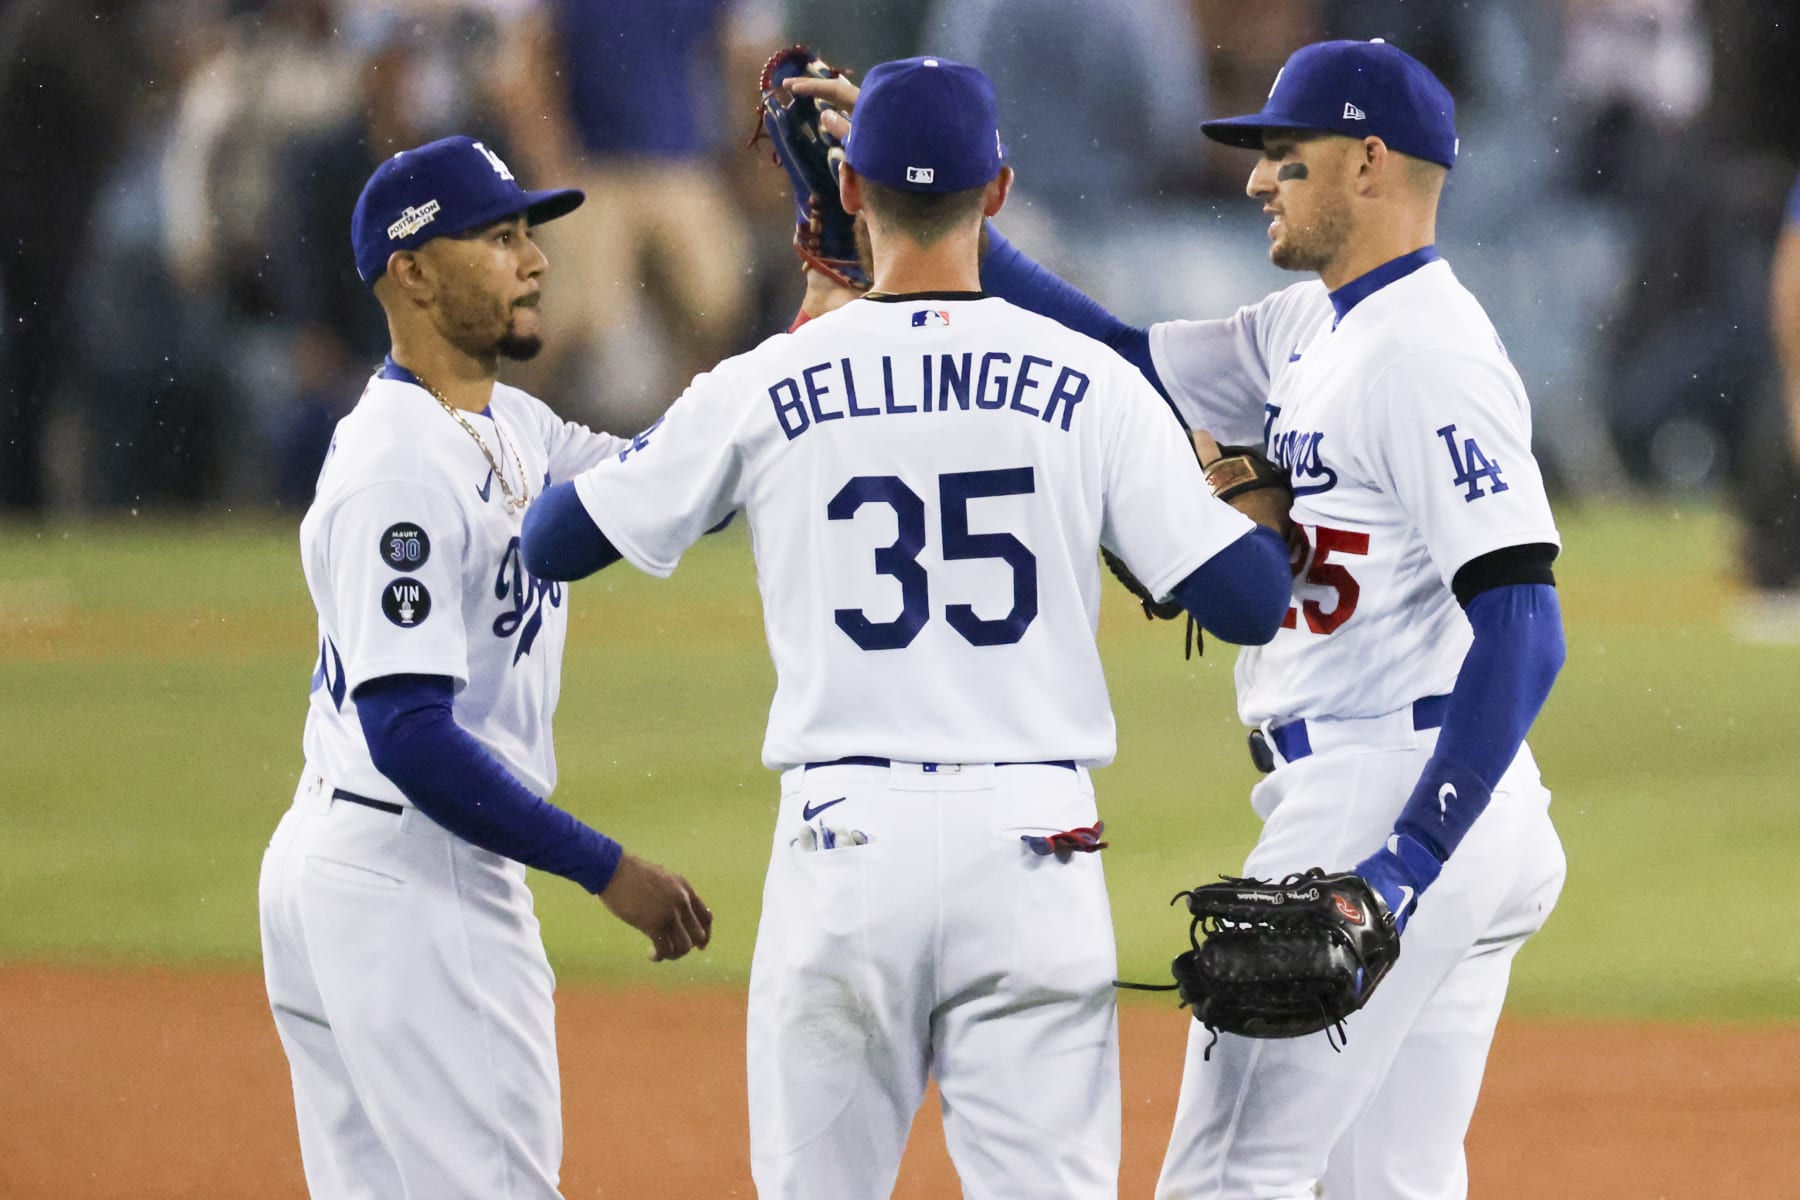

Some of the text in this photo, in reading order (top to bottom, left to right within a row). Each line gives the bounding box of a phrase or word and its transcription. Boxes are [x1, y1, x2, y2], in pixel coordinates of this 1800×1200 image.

[389, 202, 438, 236] POSTSEASON
[768, 351, 1090, 441] BELLINGER
[1436, 424, 1509, 503] LA
[390, 538, 420, 561] 30
[827, 466, 1038, 651] 35
[392, 586, 419, 602] VIN
